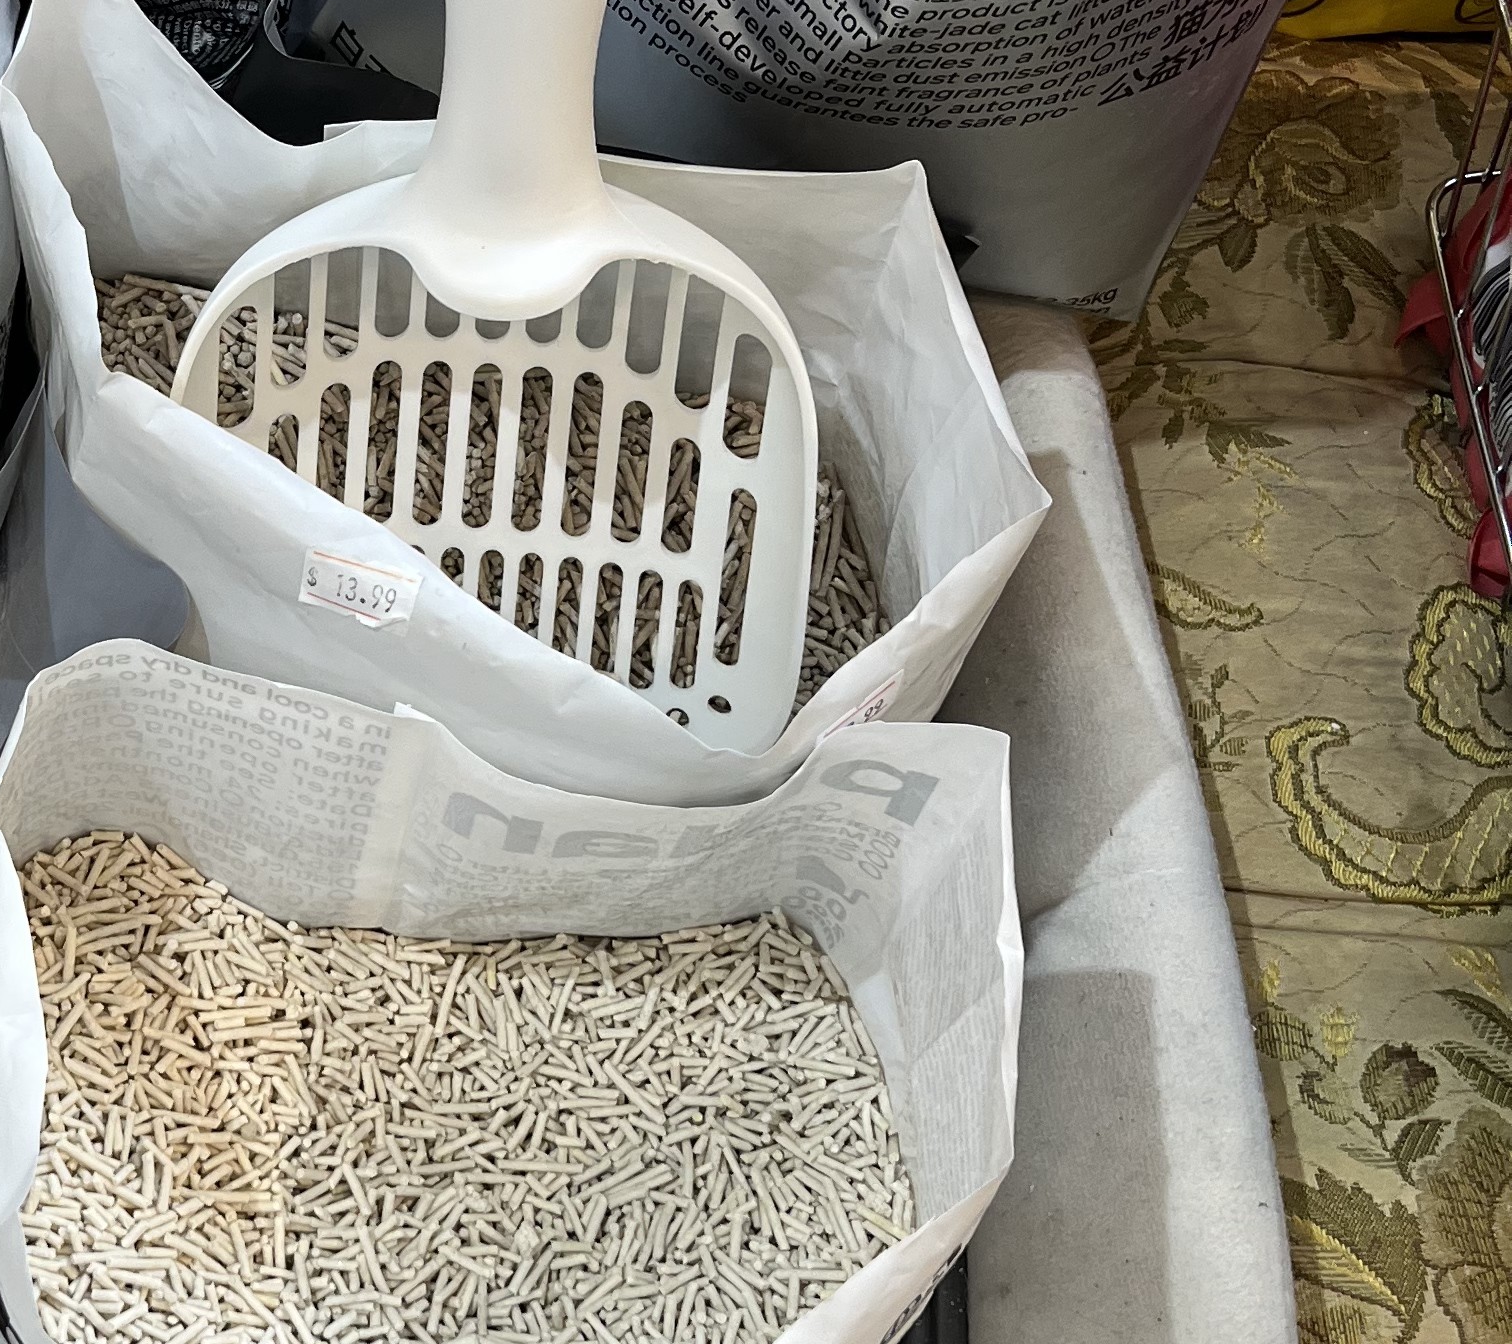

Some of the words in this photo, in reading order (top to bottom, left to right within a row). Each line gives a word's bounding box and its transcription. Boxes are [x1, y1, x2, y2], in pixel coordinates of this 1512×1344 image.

[887, 32, 1048, 55] absorption
[1055, 17, 1085, 41] of
[1015, 11, 1064, 31] cat
[648, 32, 750, 104] process
[735, 7, 817, 84] release
[823, 78, 894, 97] faint
[895, 81, 1035, 103] fragrance
[1040, 72, 1072, 91] of
[1071, 46, 1154, 88] plants
[778, 19, 824, 65] and
[824, 58, 888, 83] little
[893, 71, 961, 85] dust
[964, 56, 1088, 84] emission
[1120, 25, 1162, 53] The
[841, 49, 975, 71] particles
[982, 52, 1006, 68] in
[1015, 51, 1034, 65] a
[1041, 31, 1101, 60] high
[696, 41, 740, 81] line
[743, 80, 901, 128] guarantees
[906, 116, 952, 130] the
[957, 114, 1017, 130] safe
[1019, 107, 1079, 127] pro-
[873, 99, 941, 117] fully
[947, 83, 1097, 115] automatic
[336, 574, 397, 613] 13.99
